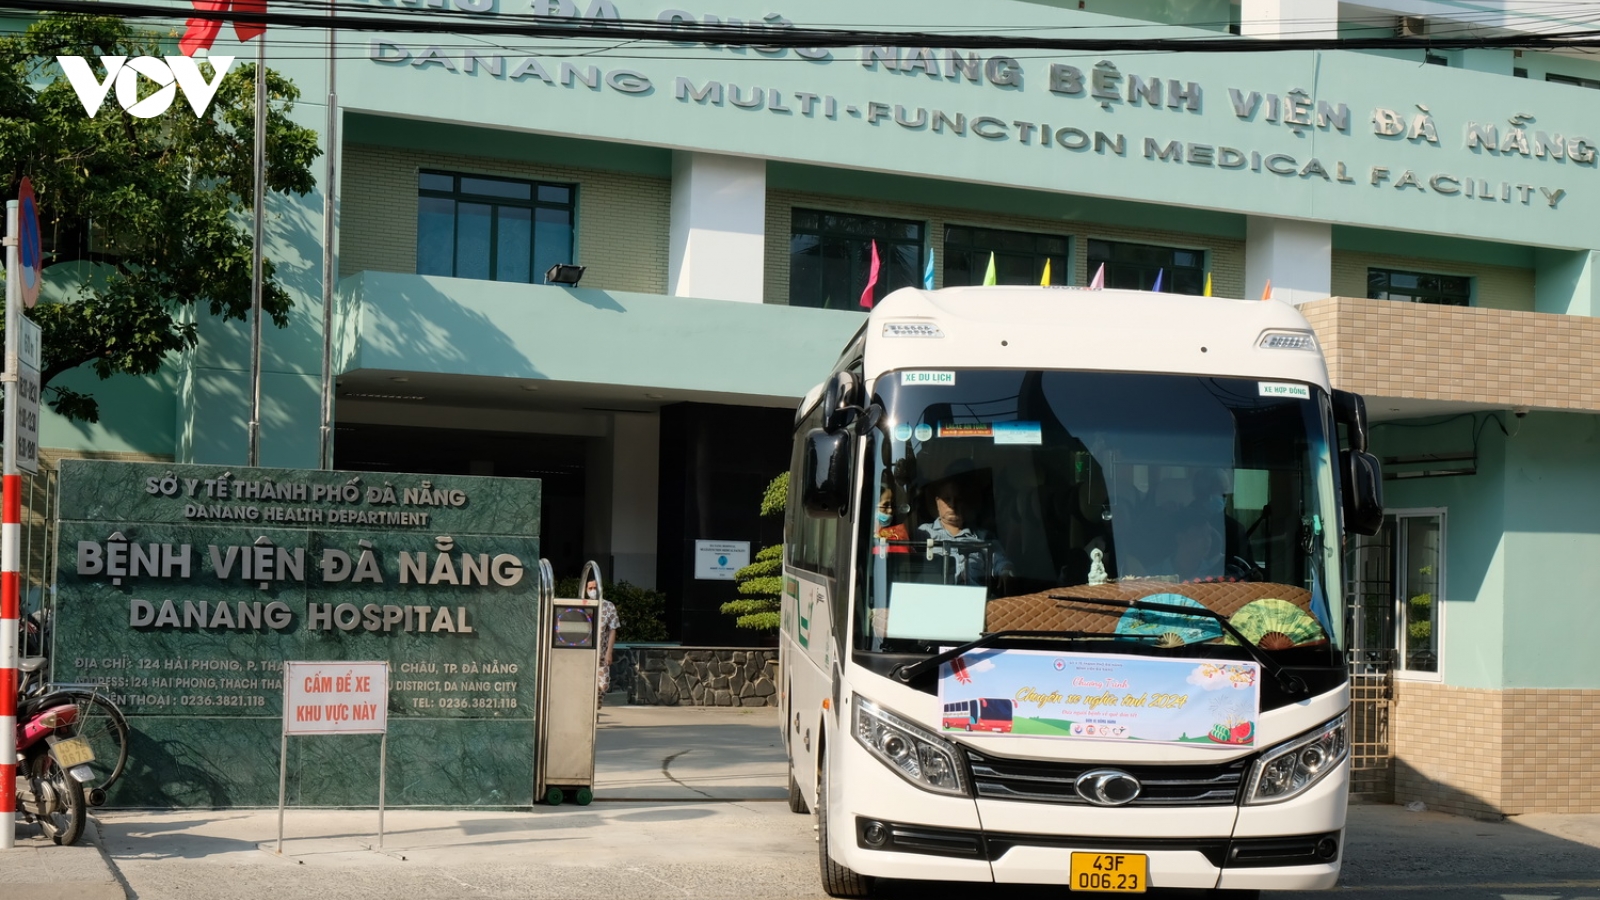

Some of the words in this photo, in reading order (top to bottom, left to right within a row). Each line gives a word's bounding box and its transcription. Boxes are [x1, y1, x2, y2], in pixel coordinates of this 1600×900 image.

[369, 38, 652, 93] DANANG
[1143, 137, 1353, 182] MEDICAL
[1370, 166, 1565, 207] FACILITY
[1049, 60, 1199, 110] BỆNH
[1228, 88, 1347, 134] VIỆN
[1372, 104, 1438, 143] ĐÀ
[1467, 112, 1597, 164] NẴNG
[905, 373, 916, 382] XE
[918, 373, 930, 382] DU
[146, 470, 178, 496] SỞ
[185, 478, 199, 497] Y
[205, 471, 232, 498] TẾ
[234, 476, 308, 501] THÀNH
[313, 476, 360, 503] PHỐ
[366, 480, 397, 504] ĐÀ
[403, 480, 467, 507] NẴNG
[185, 504, 259, 520] DANANG
[264, 507, 322, 522] HEALTH
[328, 509, 429, 526] DEPARTMENT
[77, 531, 191, 586] BỆNH
[208, 535, 305, 590] VIỆN
[320, 538, 384, 583] ĐÀ
[397, 535, 524, 587] NẴNG
[130, 599, 292, 630] DANANG
[308, 602, 473, 633] HOSPITAL
[75, 657, 98, 672] ĐỊA
[138, 658, 161, 670] 124
[164, 655, 188, 670] HẢI
[246, 660, 258, 671] P.
[400, 660, 439, 675] CHÂU,
[443, 662, 458, 674] TP.
[462, 660, 479, 674] ĐÀ
[130, 677, 148, 688] 124
[152, 677, 172, 689] HAI
[175, 677, 219, 691] PHONG,
[220, 678, 259, 690] THACH
[396, 680, 442, 693] DISTRICT,
[444, 681, 458, 692] DA
[462, 681, 491, 692] NANG
[494, 681, 518, 692] CITY
[304, 671, 332, 693] CẤM
[335, 669, 353, 693] ĐỂ
[355, 676, 371, 692] XE
[181, 695, 266, 707] 0236.3821.118
[413, 697, 434, 709] TEL:
[438, 697, 517, 709] 0236.3821.118
[1015, 687, 1063, 709] Chuyến
[1065, 694, 1081, 704] xe
[1148, 693, 1188, 709] 2024
[296, 704, 322, 722] KHU
[325, 703, 349, 724] VỰC
[352, 701, 377, 721] NÀY
[1093, 855, 1125, 871] 43F
[1079, 872, 1138, 890] 006.23
